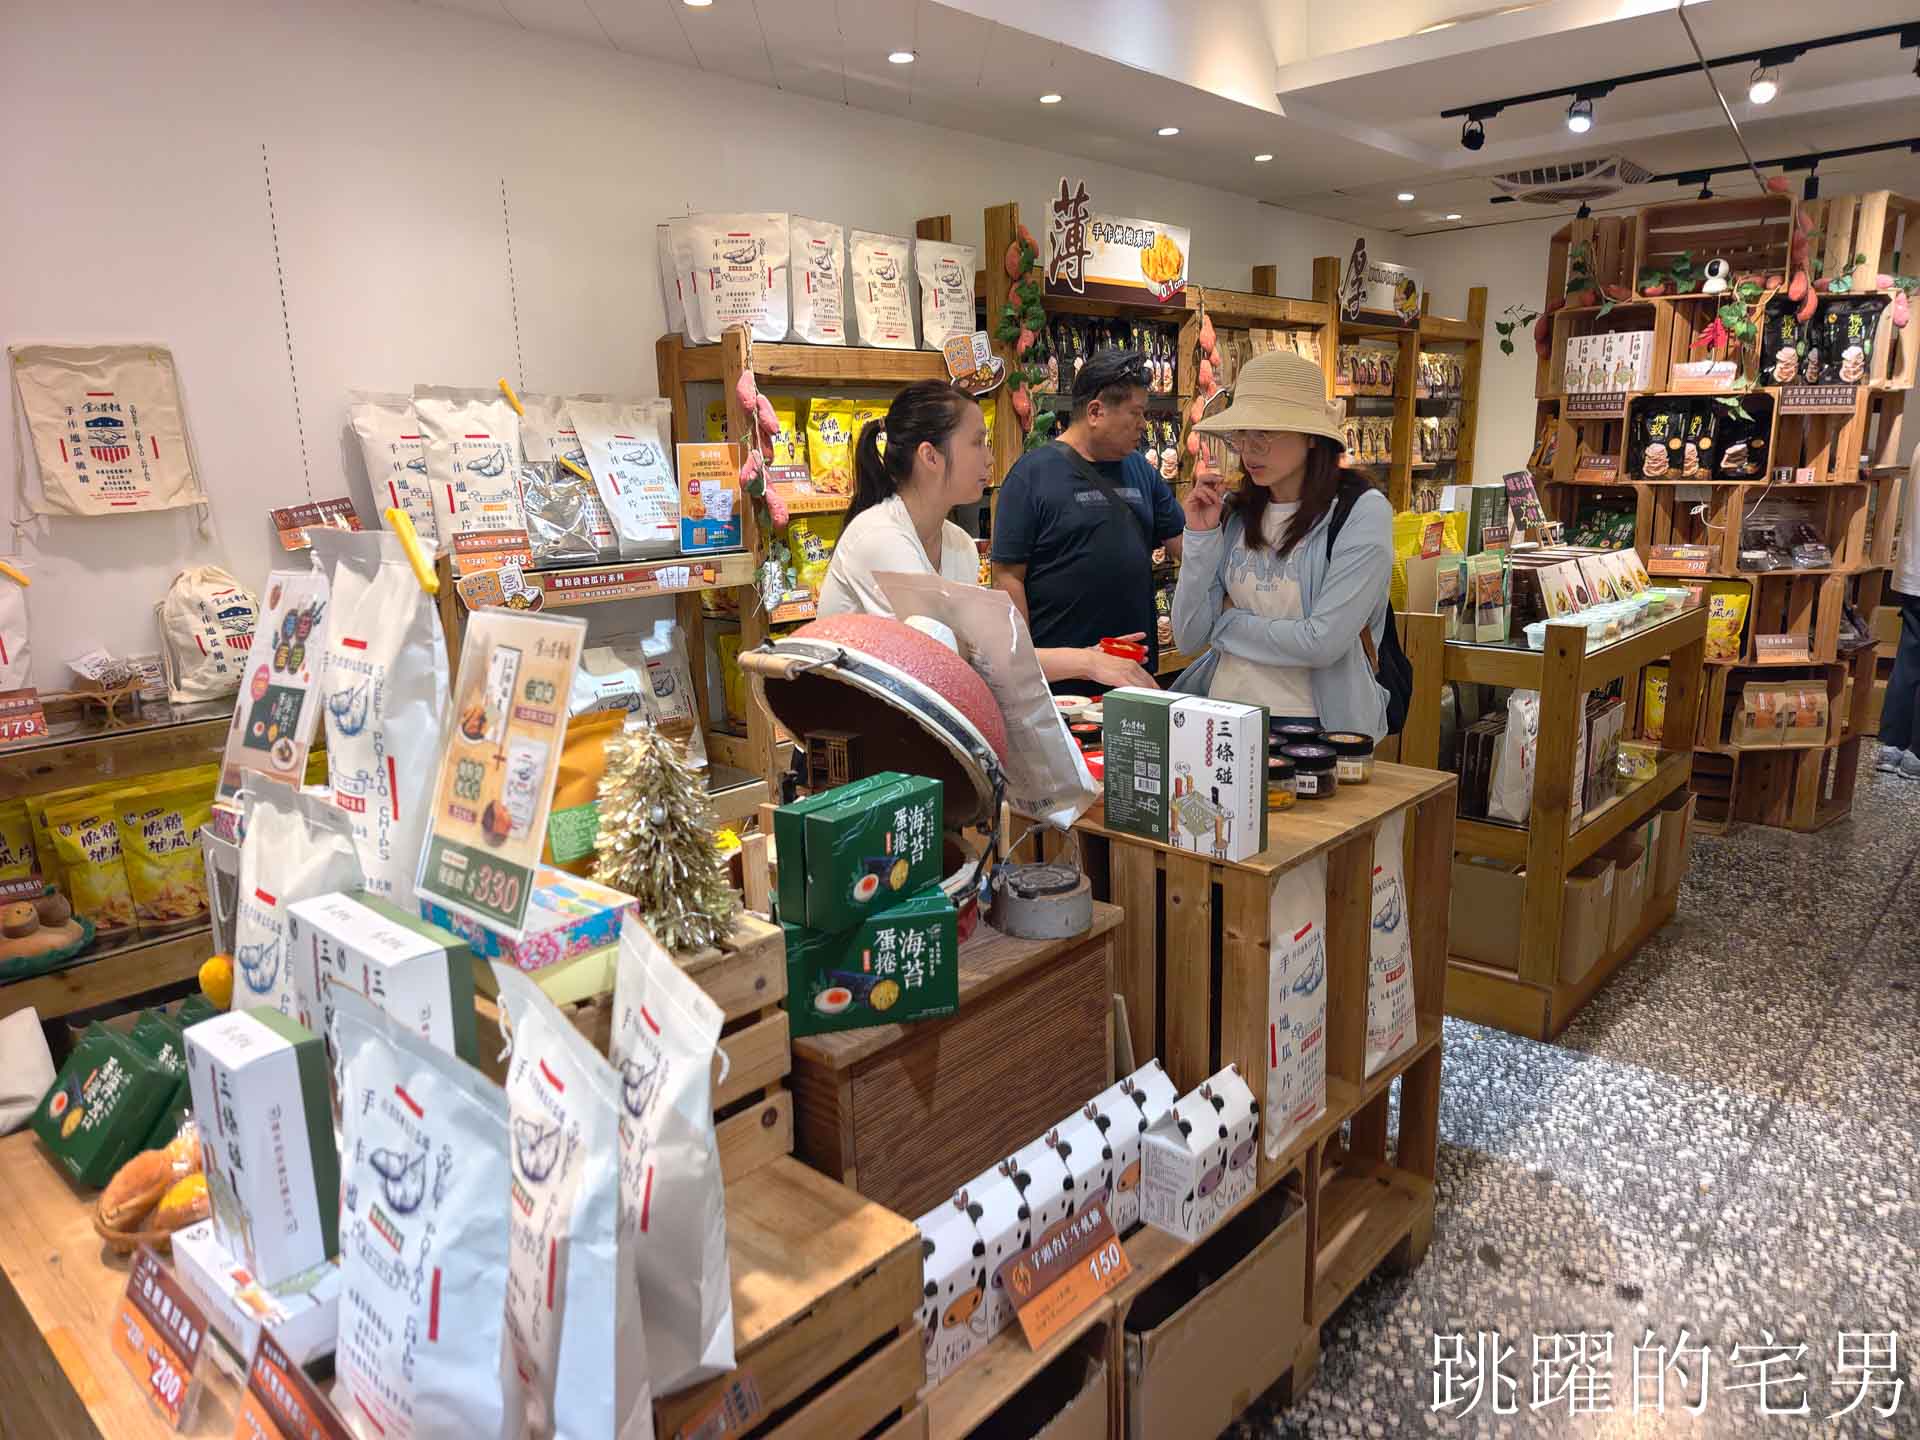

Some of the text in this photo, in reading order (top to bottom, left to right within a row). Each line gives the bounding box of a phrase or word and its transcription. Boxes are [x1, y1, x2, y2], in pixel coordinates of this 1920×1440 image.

[1050, 178, 1091, 294] 薄
[1, 719, 35, 737] 179
[1215, 720, 1234, 785] 三條碰
[374, 731, 387, 797] POTATO
[380, 806, 391, 860] CHIPS
[908, 805, 926, 865] 海苔
[898, 928, 927, 991] 海苔
[1089, 1243, 1121, 1281] 150
[151, 1359, 182, 1404] 200
